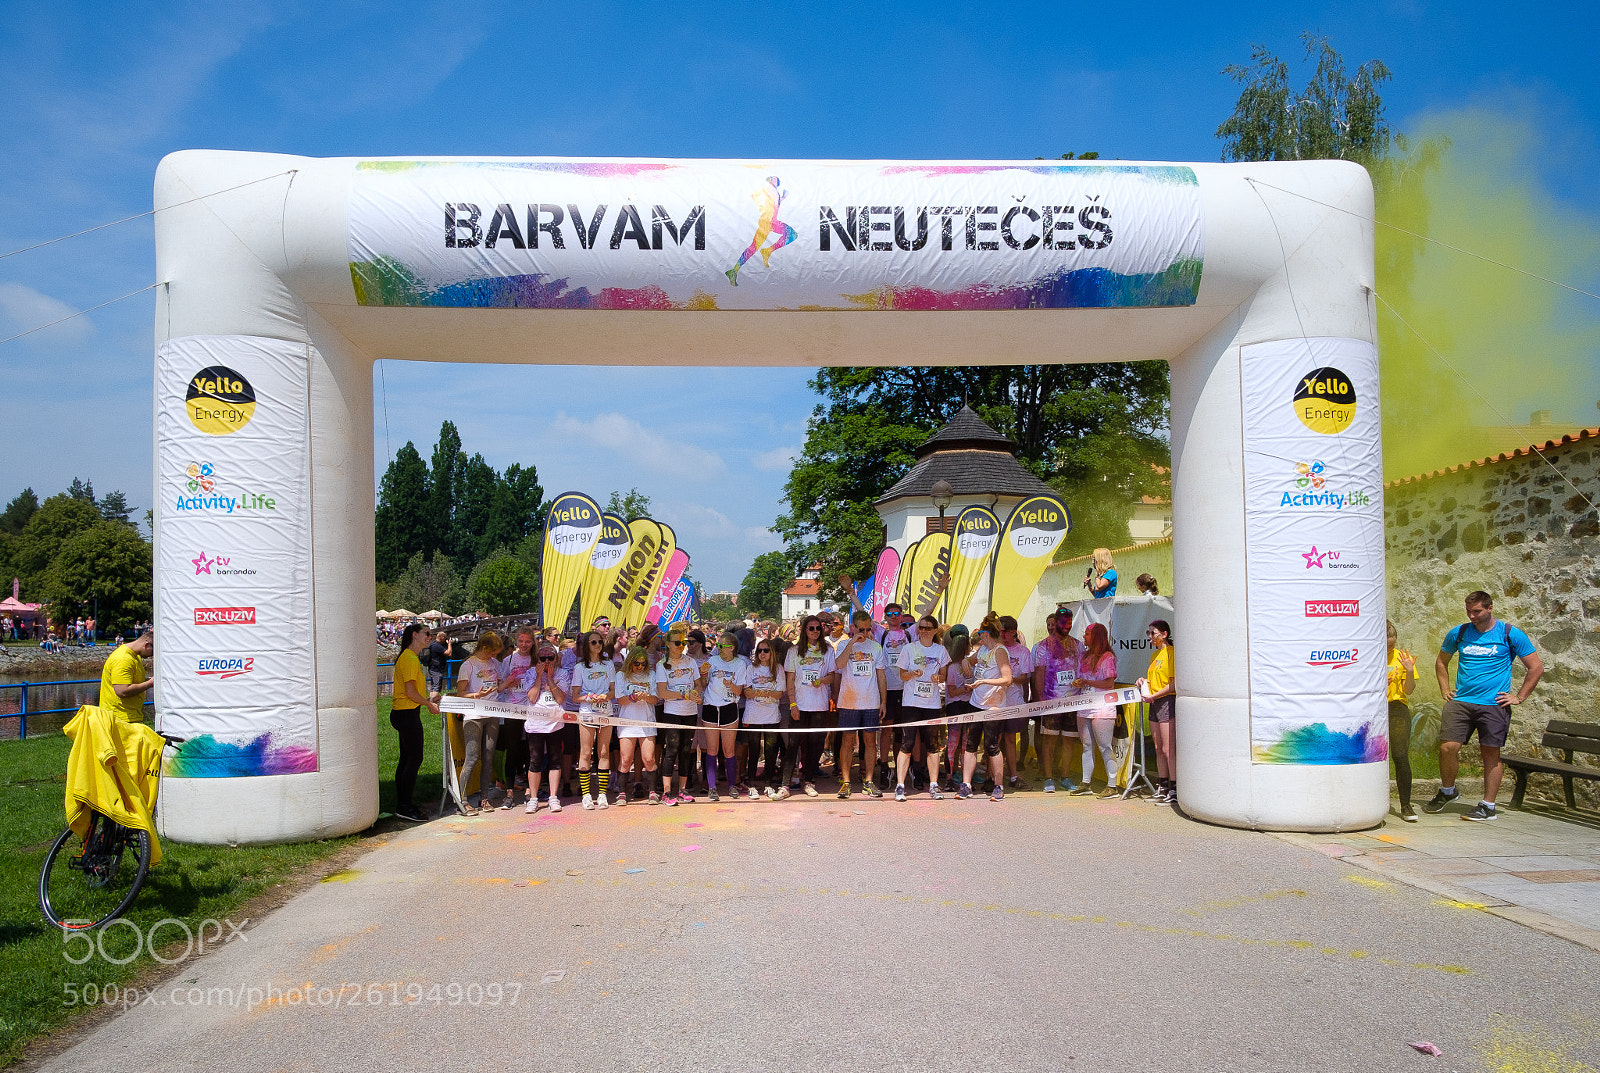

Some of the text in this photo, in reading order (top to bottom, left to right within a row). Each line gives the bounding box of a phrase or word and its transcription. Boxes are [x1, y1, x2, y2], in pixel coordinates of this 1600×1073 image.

[819, 195, 1113, 252] NEUTEČEŠ
[194, 377, 244, 396] Yello
[1304, 377, 1349, 396] Yello
[195, 406, 245, 423] Energy
[1305, 406, 1350, 422] Energy
[175, 493, 276, 514] Activity.Life
[1280, 491, 1370, 510] Activity.Life
[553, 506, 591, 524] Yello
[1020, 508, 1058, 525] Yello
[961, 517, 992, 531] Yello
[555, 530, 593, 545] Energy
[961, 537, 993, 550] Energy
[1017, 534, 1057, 547] Energy
[216, 555, 231, 566] tv
[591, 547, 623, 561] Energy
[1327, 551, 1341, 561] tv
[608, 534, 656, 610] Nikon
[195, 609, 255, 623] EXKLUZIV
[1307, 603, 1358, 614] EXKLUZIV
[1120, 639, 1158, 650] NEUT
